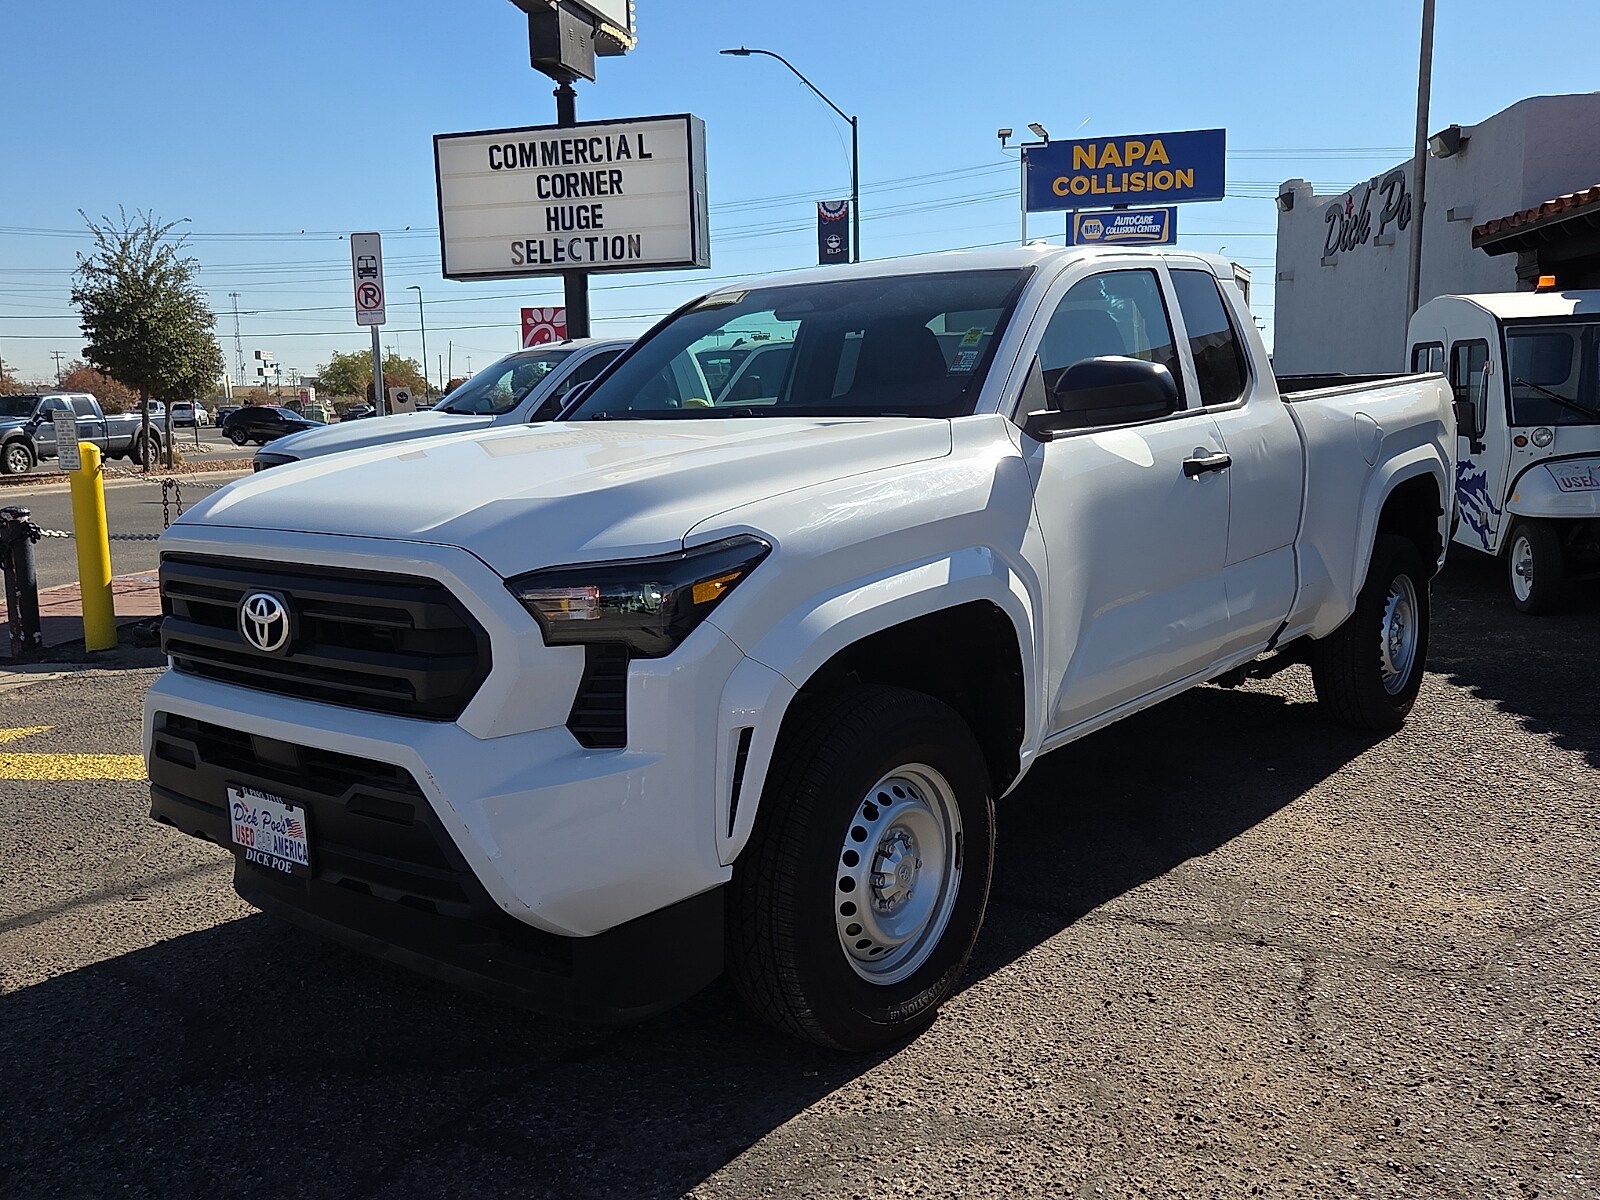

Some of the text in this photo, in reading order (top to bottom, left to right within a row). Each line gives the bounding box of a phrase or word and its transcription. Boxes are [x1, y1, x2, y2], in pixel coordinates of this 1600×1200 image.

[488, 133, 653, 170] COMMERCIAL
[1073, 139, 1170, 170] NAPA
[536, 169, 623, 199] CORNER
[1052, 168, 1194, 197] COLLISION
[545, 203, 604, 232] HUGE
[1324, 170, 1414, 257] Dick Po
[1084, 224, 1101, 235] NAPA
[1105, 224, 1161, 235] COLLISION CENTER
[511, 234, 641, 265] SELECTION
[1561, 476, 1600, 488] USED
[233, 802, 287, 835] Dick Poe's
[235, 823, 255, 847] USED
[273, 834, 308, 863] AMERICA
[245, 848, 293, 874] DICK POE
